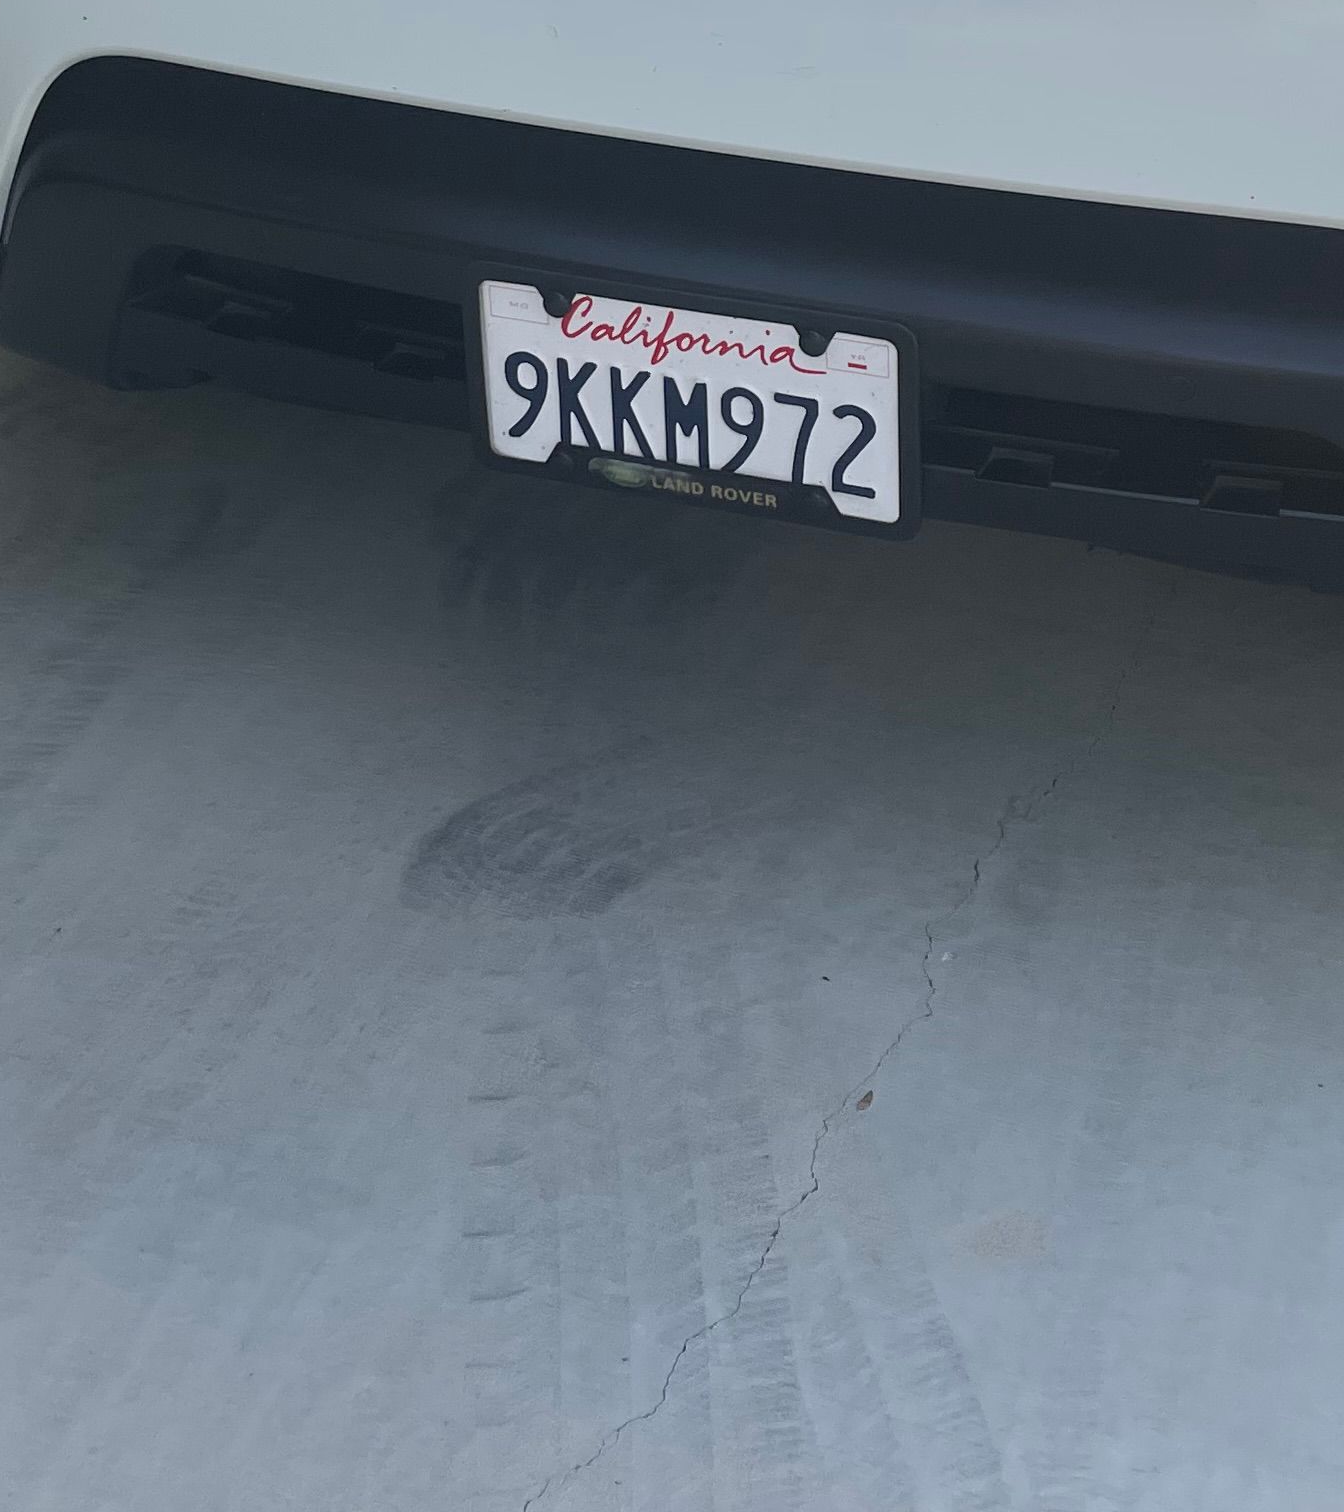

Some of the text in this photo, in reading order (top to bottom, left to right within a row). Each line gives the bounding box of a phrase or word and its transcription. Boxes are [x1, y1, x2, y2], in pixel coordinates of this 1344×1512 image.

[560, 295, 827, 375] California
[504, 351, 877, 500] 9KKM972
[650, 473, 778, 509] LAND ROVER
